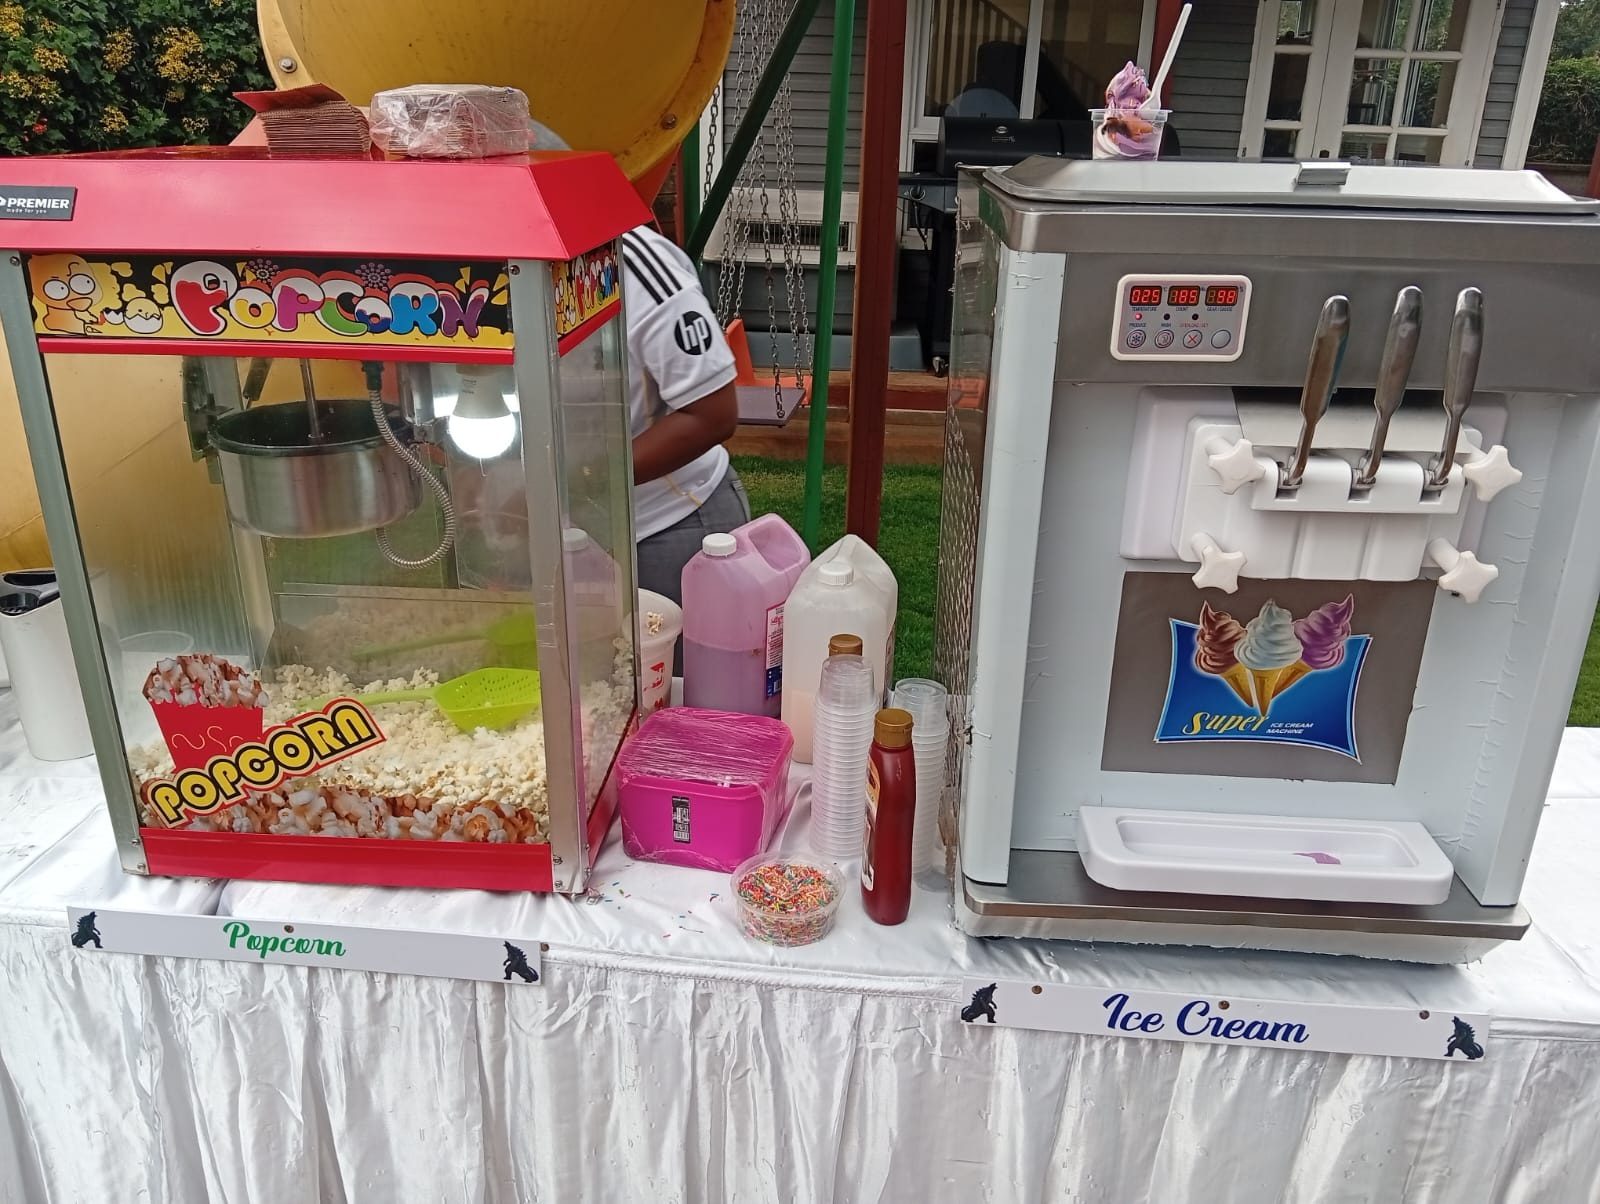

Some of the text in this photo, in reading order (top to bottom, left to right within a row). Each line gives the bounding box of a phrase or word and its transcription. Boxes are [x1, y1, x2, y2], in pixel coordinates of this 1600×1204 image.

[7, 197, 70, 208] PREMIER
[170, 260, 490, 338] POPCORN
[678, 314, 709, 354] hp
[149, 704, 377, 827] POPCORN
[222, 921, 347, 959] Popcorn
[1102, 993, 1310, 1043] Ice Cream
